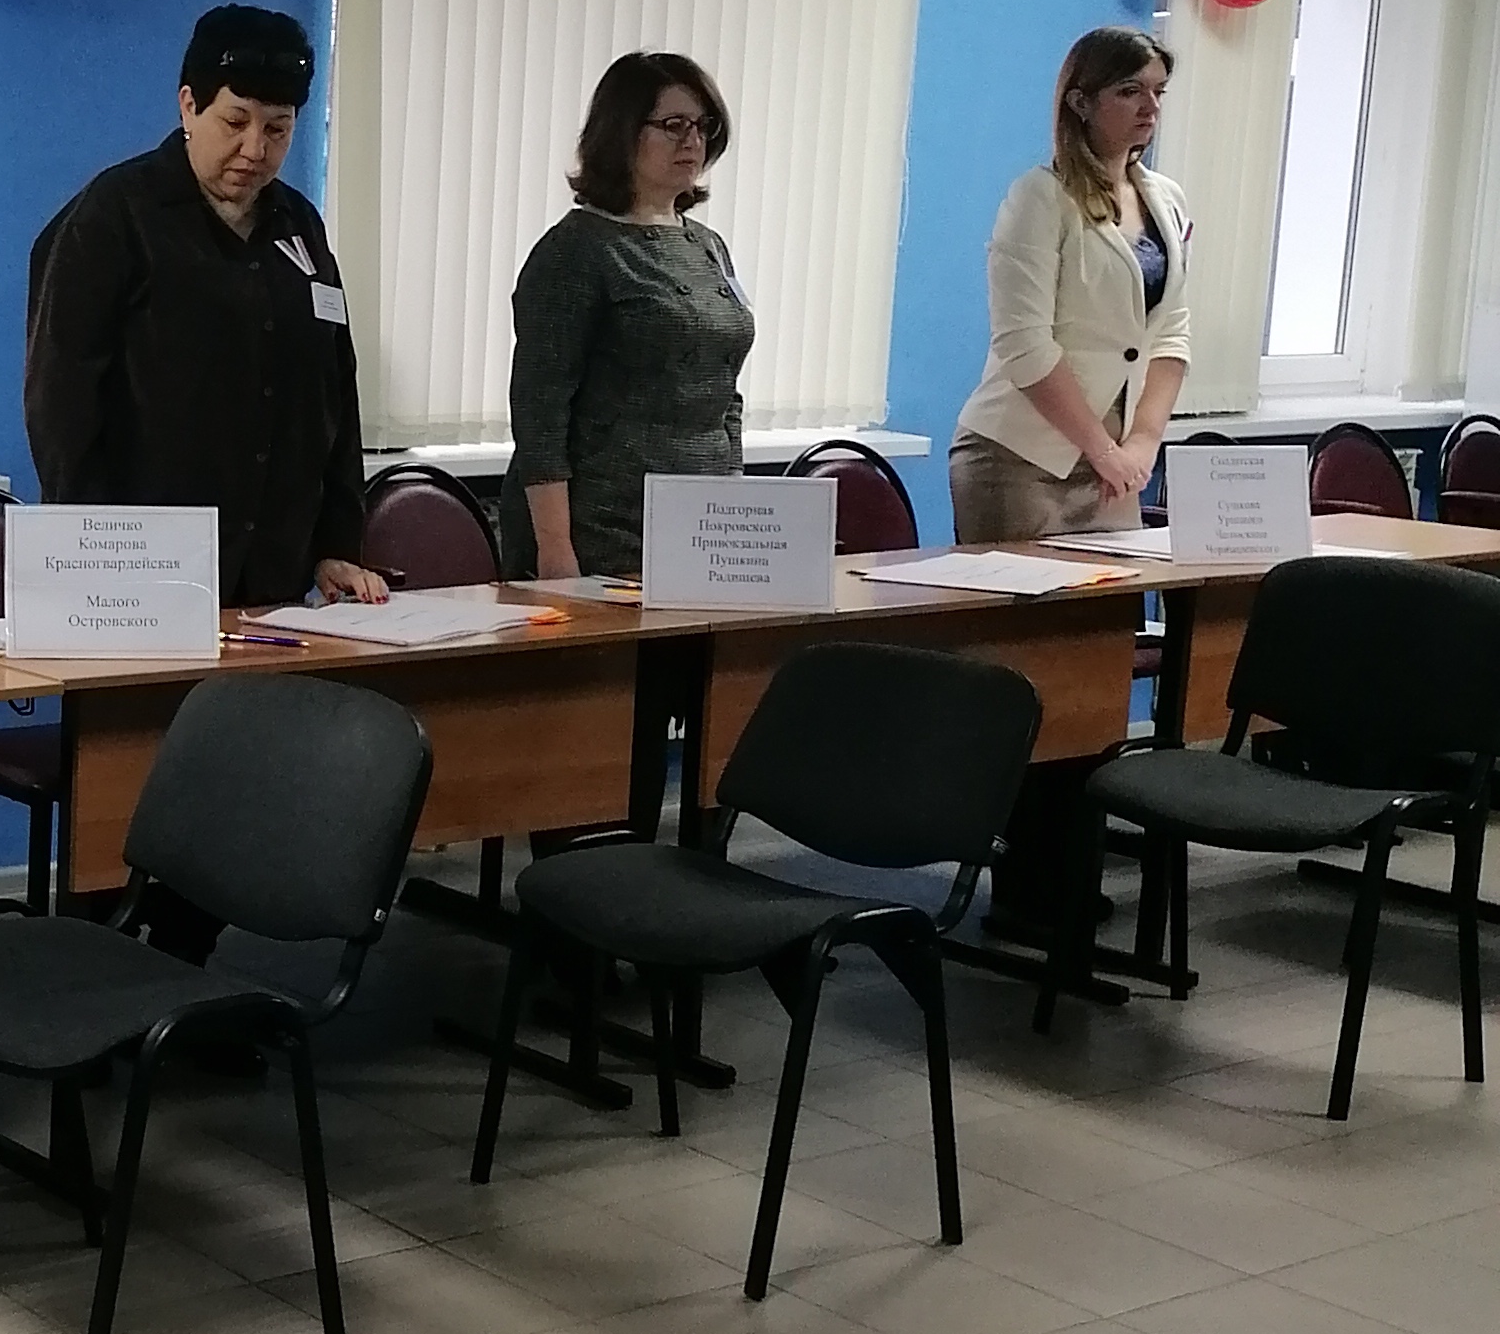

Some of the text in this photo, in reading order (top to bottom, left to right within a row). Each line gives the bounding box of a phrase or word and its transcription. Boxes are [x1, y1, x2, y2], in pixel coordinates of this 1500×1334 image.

[706, 502, 775, 518] Подгорная
[82, 518, 143, 532] Величко
[699, 519, 782, 535] Покровского
[78, 537, 148, 553] Комарова
[691, 536, 788, 552] Привокзальная
[45, 557, 181, 572] Красногвардейская
[709, 553, 770, 568] Пушкина
[86, 595, 140, 608] Малого
[68, 615, 159, 630] Островского
